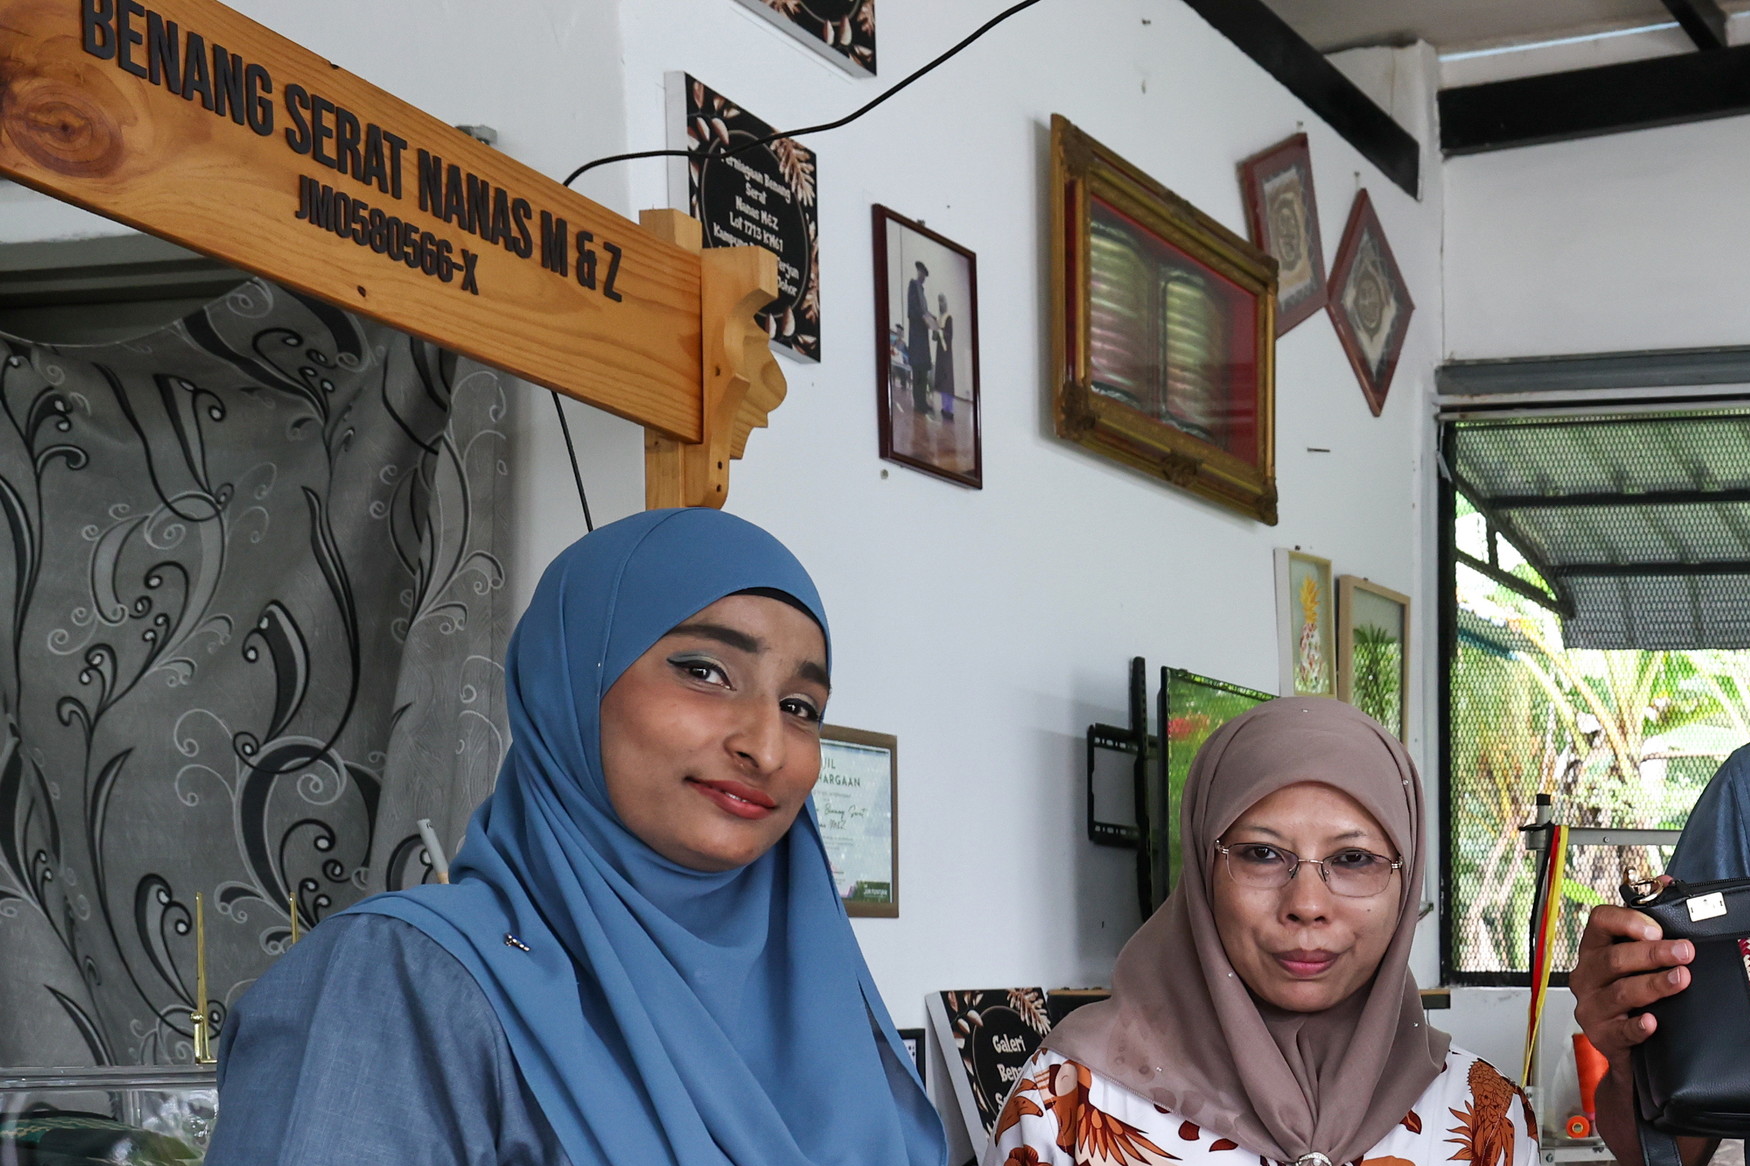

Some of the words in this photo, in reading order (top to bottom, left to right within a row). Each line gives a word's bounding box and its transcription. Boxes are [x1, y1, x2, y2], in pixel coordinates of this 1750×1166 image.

[81, 0, 275, 136] BENANG
[284, 83, 408, 200] SERAT
[417, 147, 533, 259] NANAS
[540, 209, 568, 277] M
[576, 230, 597, 291] &
[602, 241, 623, 303] Z
[819, 773, 861, 787] ARGAAN
[991, 1034, 1027, 1054] Galeri
